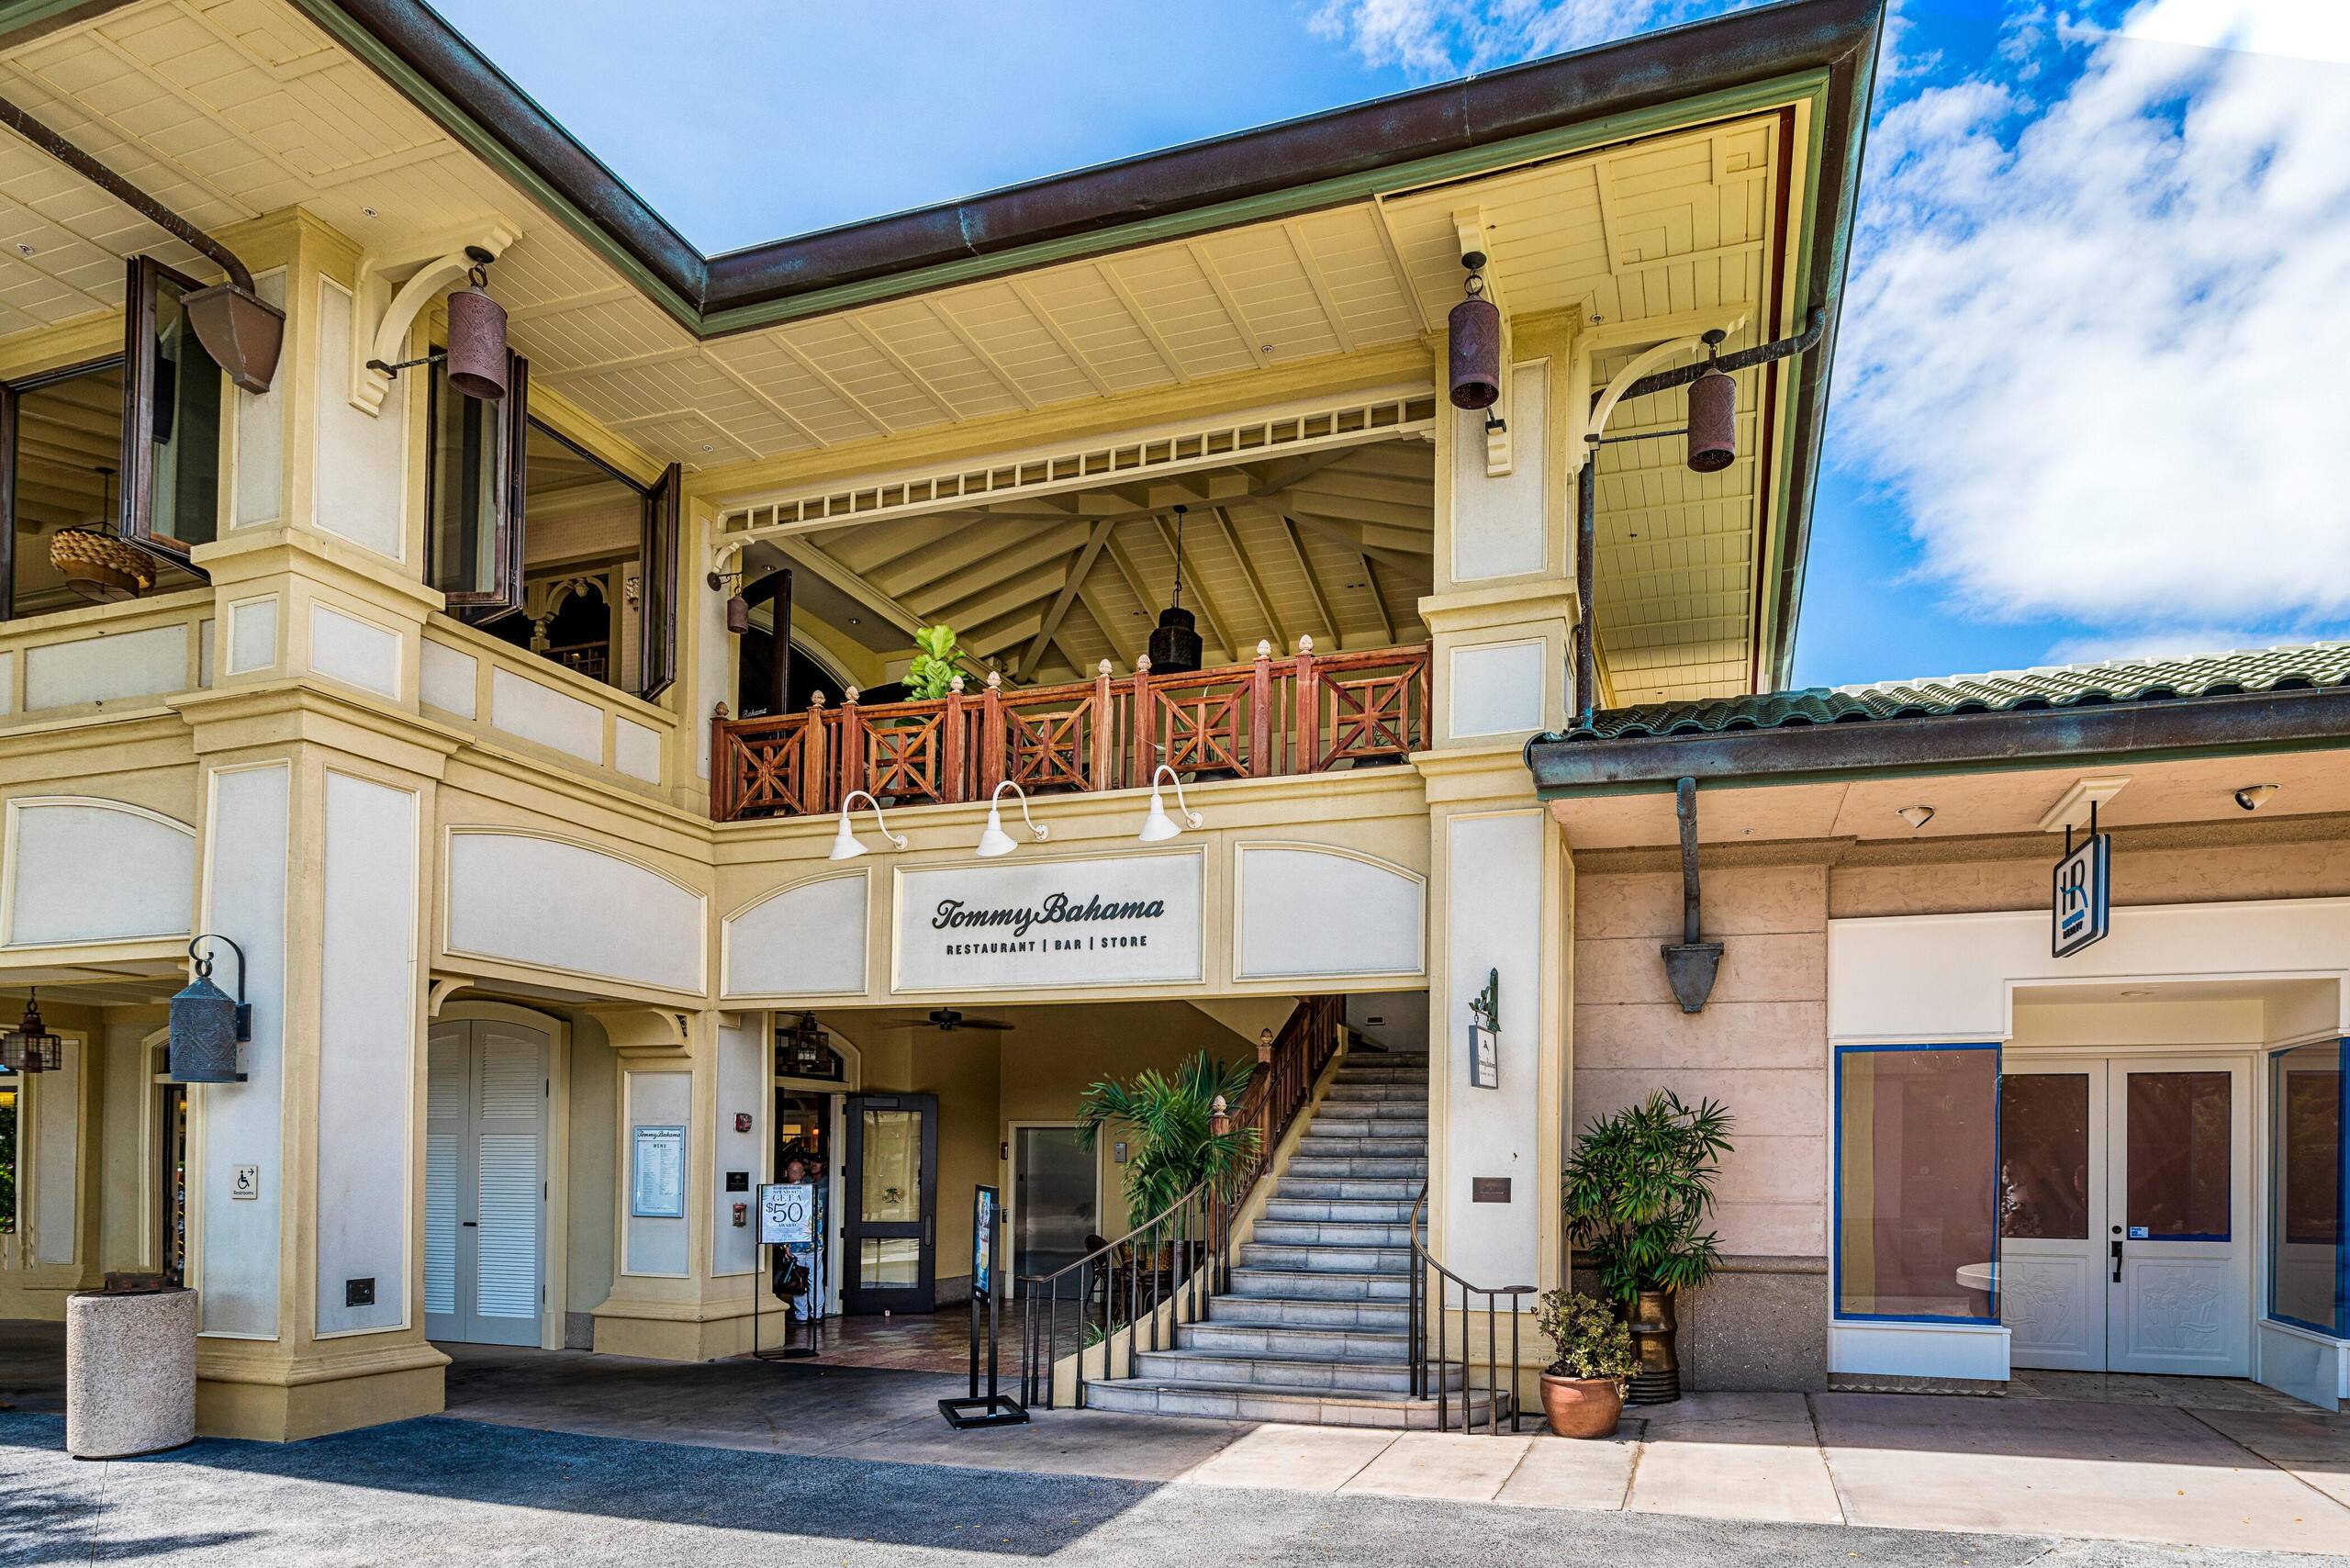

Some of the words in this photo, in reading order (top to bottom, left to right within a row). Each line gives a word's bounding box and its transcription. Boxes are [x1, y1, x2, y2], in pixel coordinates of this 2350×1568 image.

[932, 899, 1035, 937] Tommy
[1035, 891, 1164, 924] Bahama
[946, 941, 1035, 956] RESTAURANT
[1055, 939, 1082, 950] BAR
[1101, 935, 1147, 948] STORE
[637, 1130, 658, 1139] Tommy
[766, 1202, 803, 1222] $50
